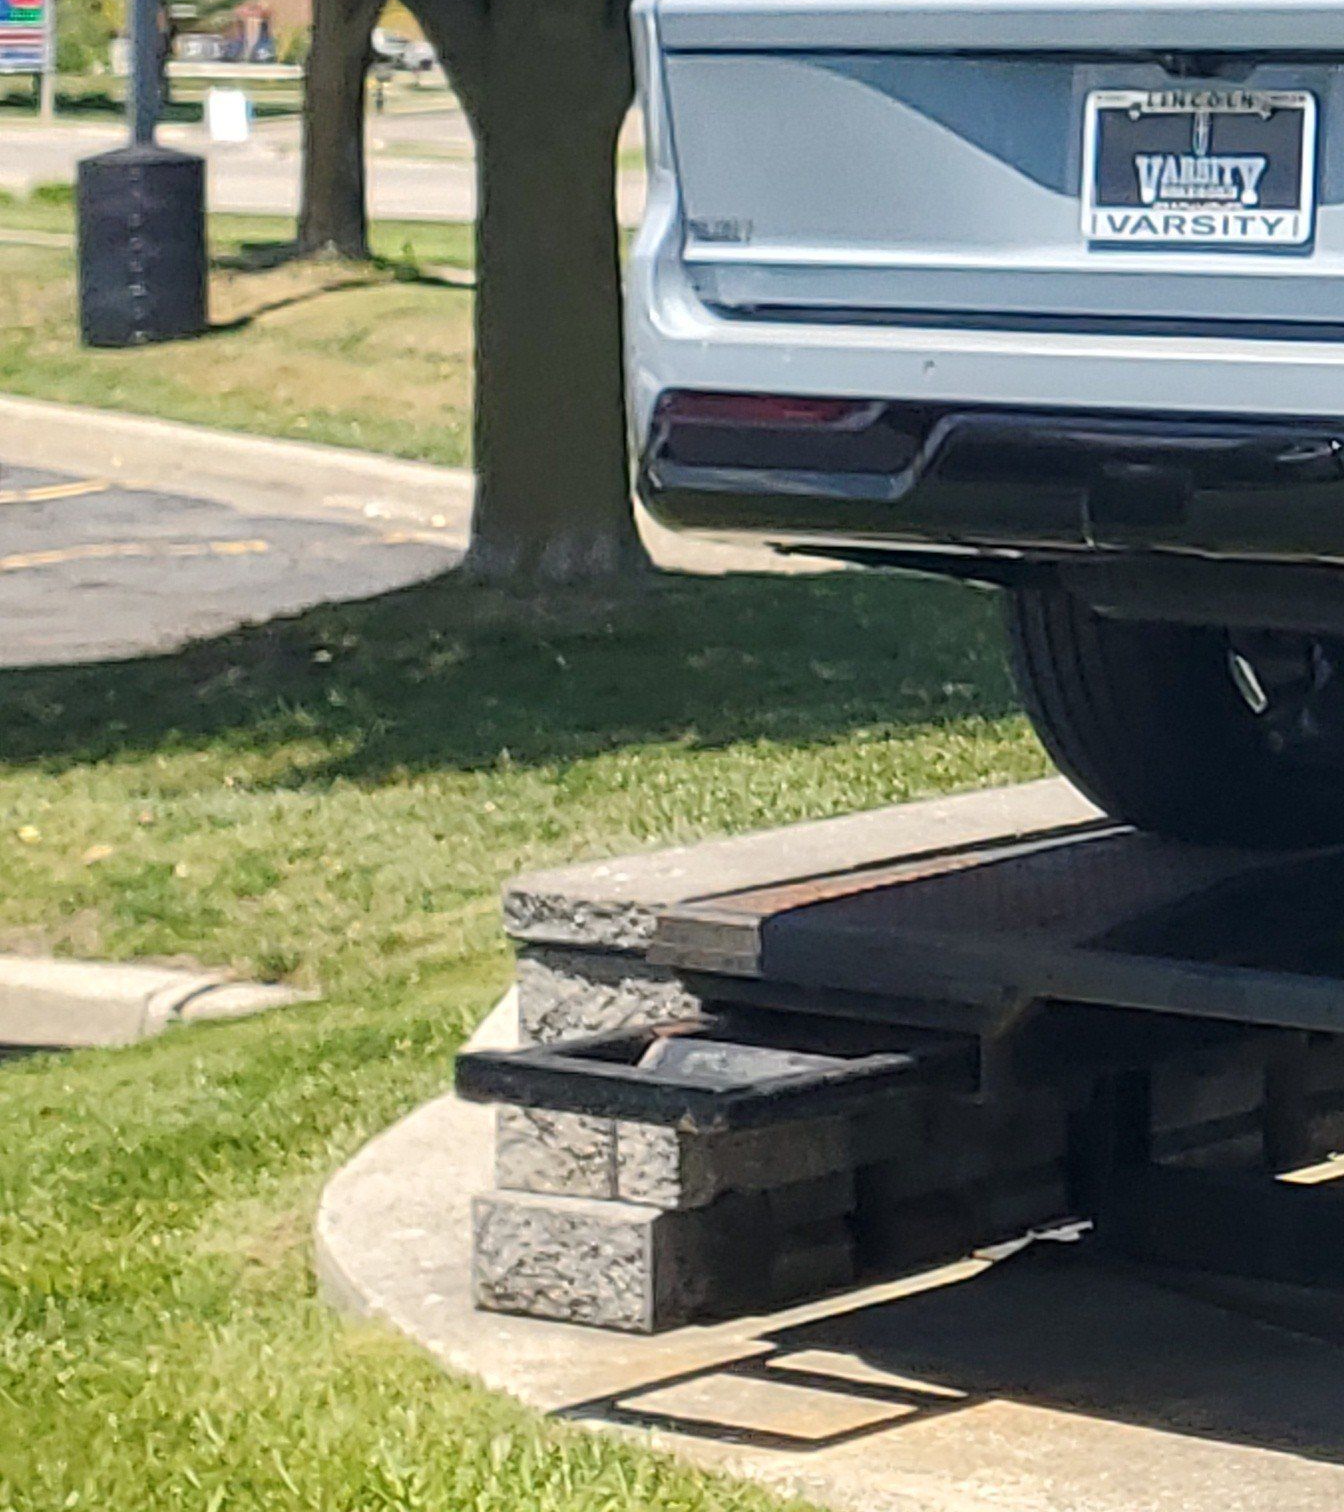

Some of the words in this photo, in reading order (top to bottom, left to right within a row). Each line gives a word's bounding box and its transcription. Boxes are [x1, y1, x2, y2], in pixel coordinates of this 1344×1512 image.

[1148, 90, 1253, 108] LINCOLN
[1136, 155, 1266, 203] VARSITY
[1108, 216, 1284, 236] VARSITY
